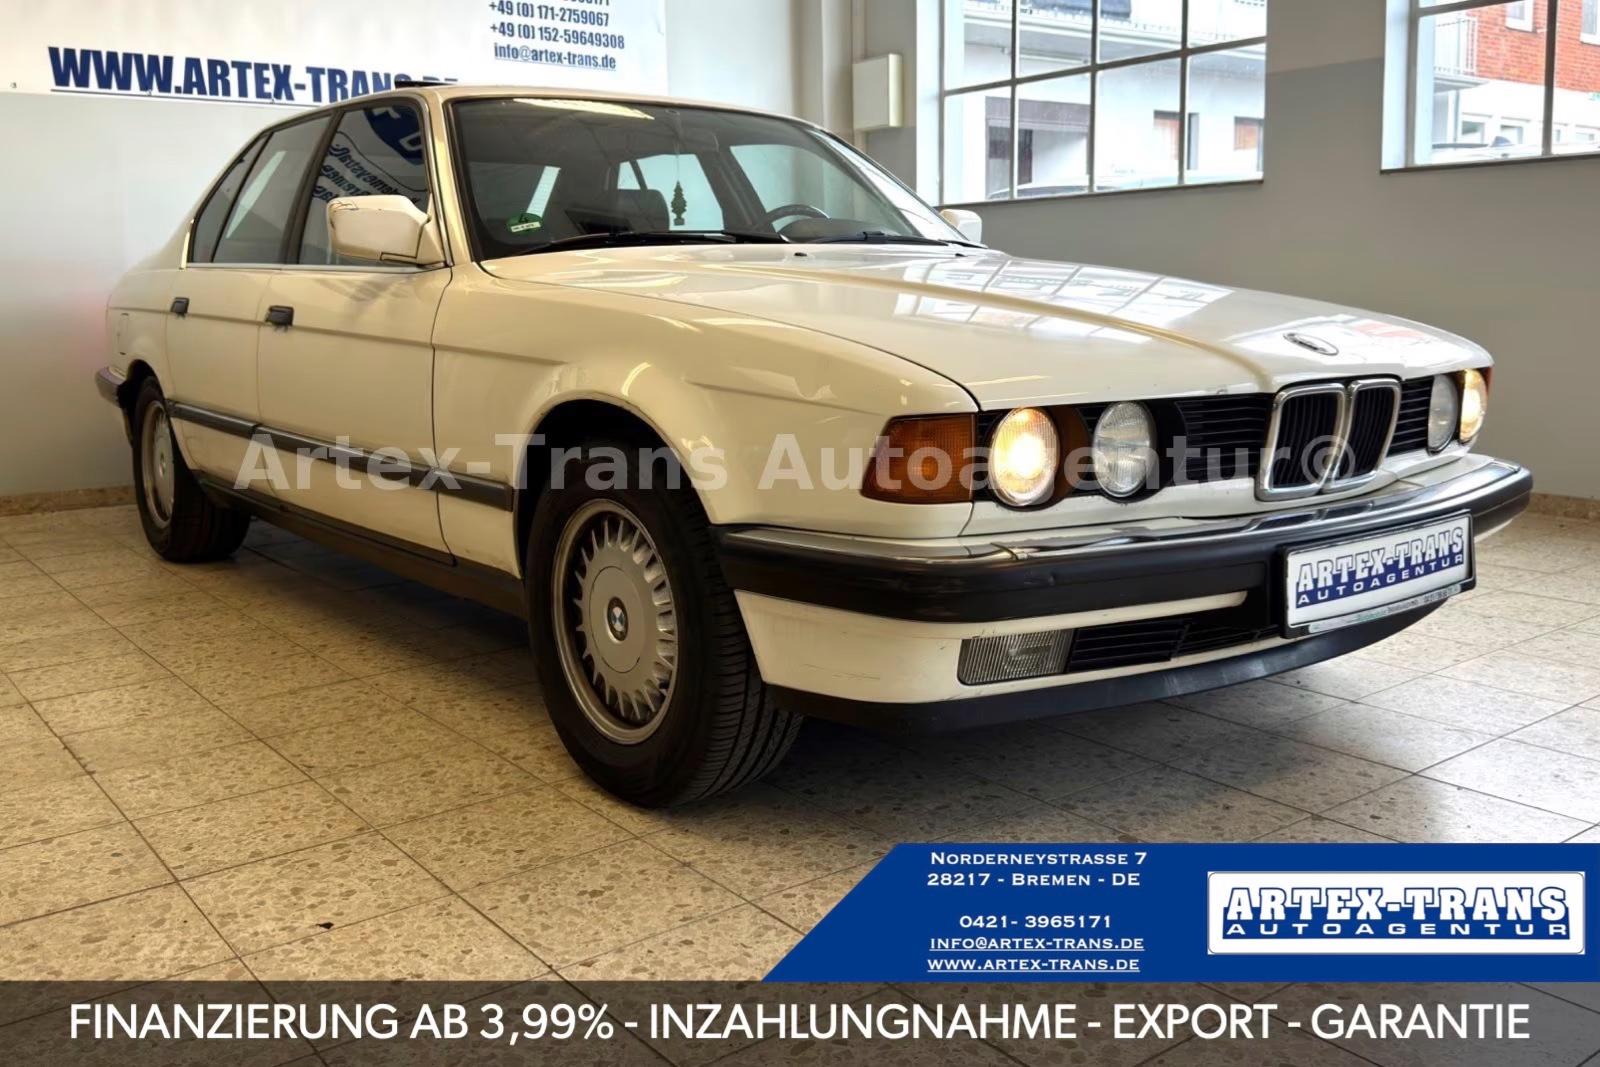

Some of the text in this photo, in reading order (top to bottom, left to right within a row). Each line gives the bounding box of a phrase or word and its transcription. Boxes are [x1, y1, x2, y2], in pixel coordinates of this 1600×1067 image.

[488, 0, 514, 16] +49
[537, 4, 610, 27] 171-2759067
[490, 21, 515, 38] +49
[538, 26, 626, 50] 152-59649308
[493, 42, 617, 71] info@artex-trans.de
[1297, 526, 1465, 593] ARTEX-TRANS
[1297, 553, 1464, 606] AUTOAGENTUR
